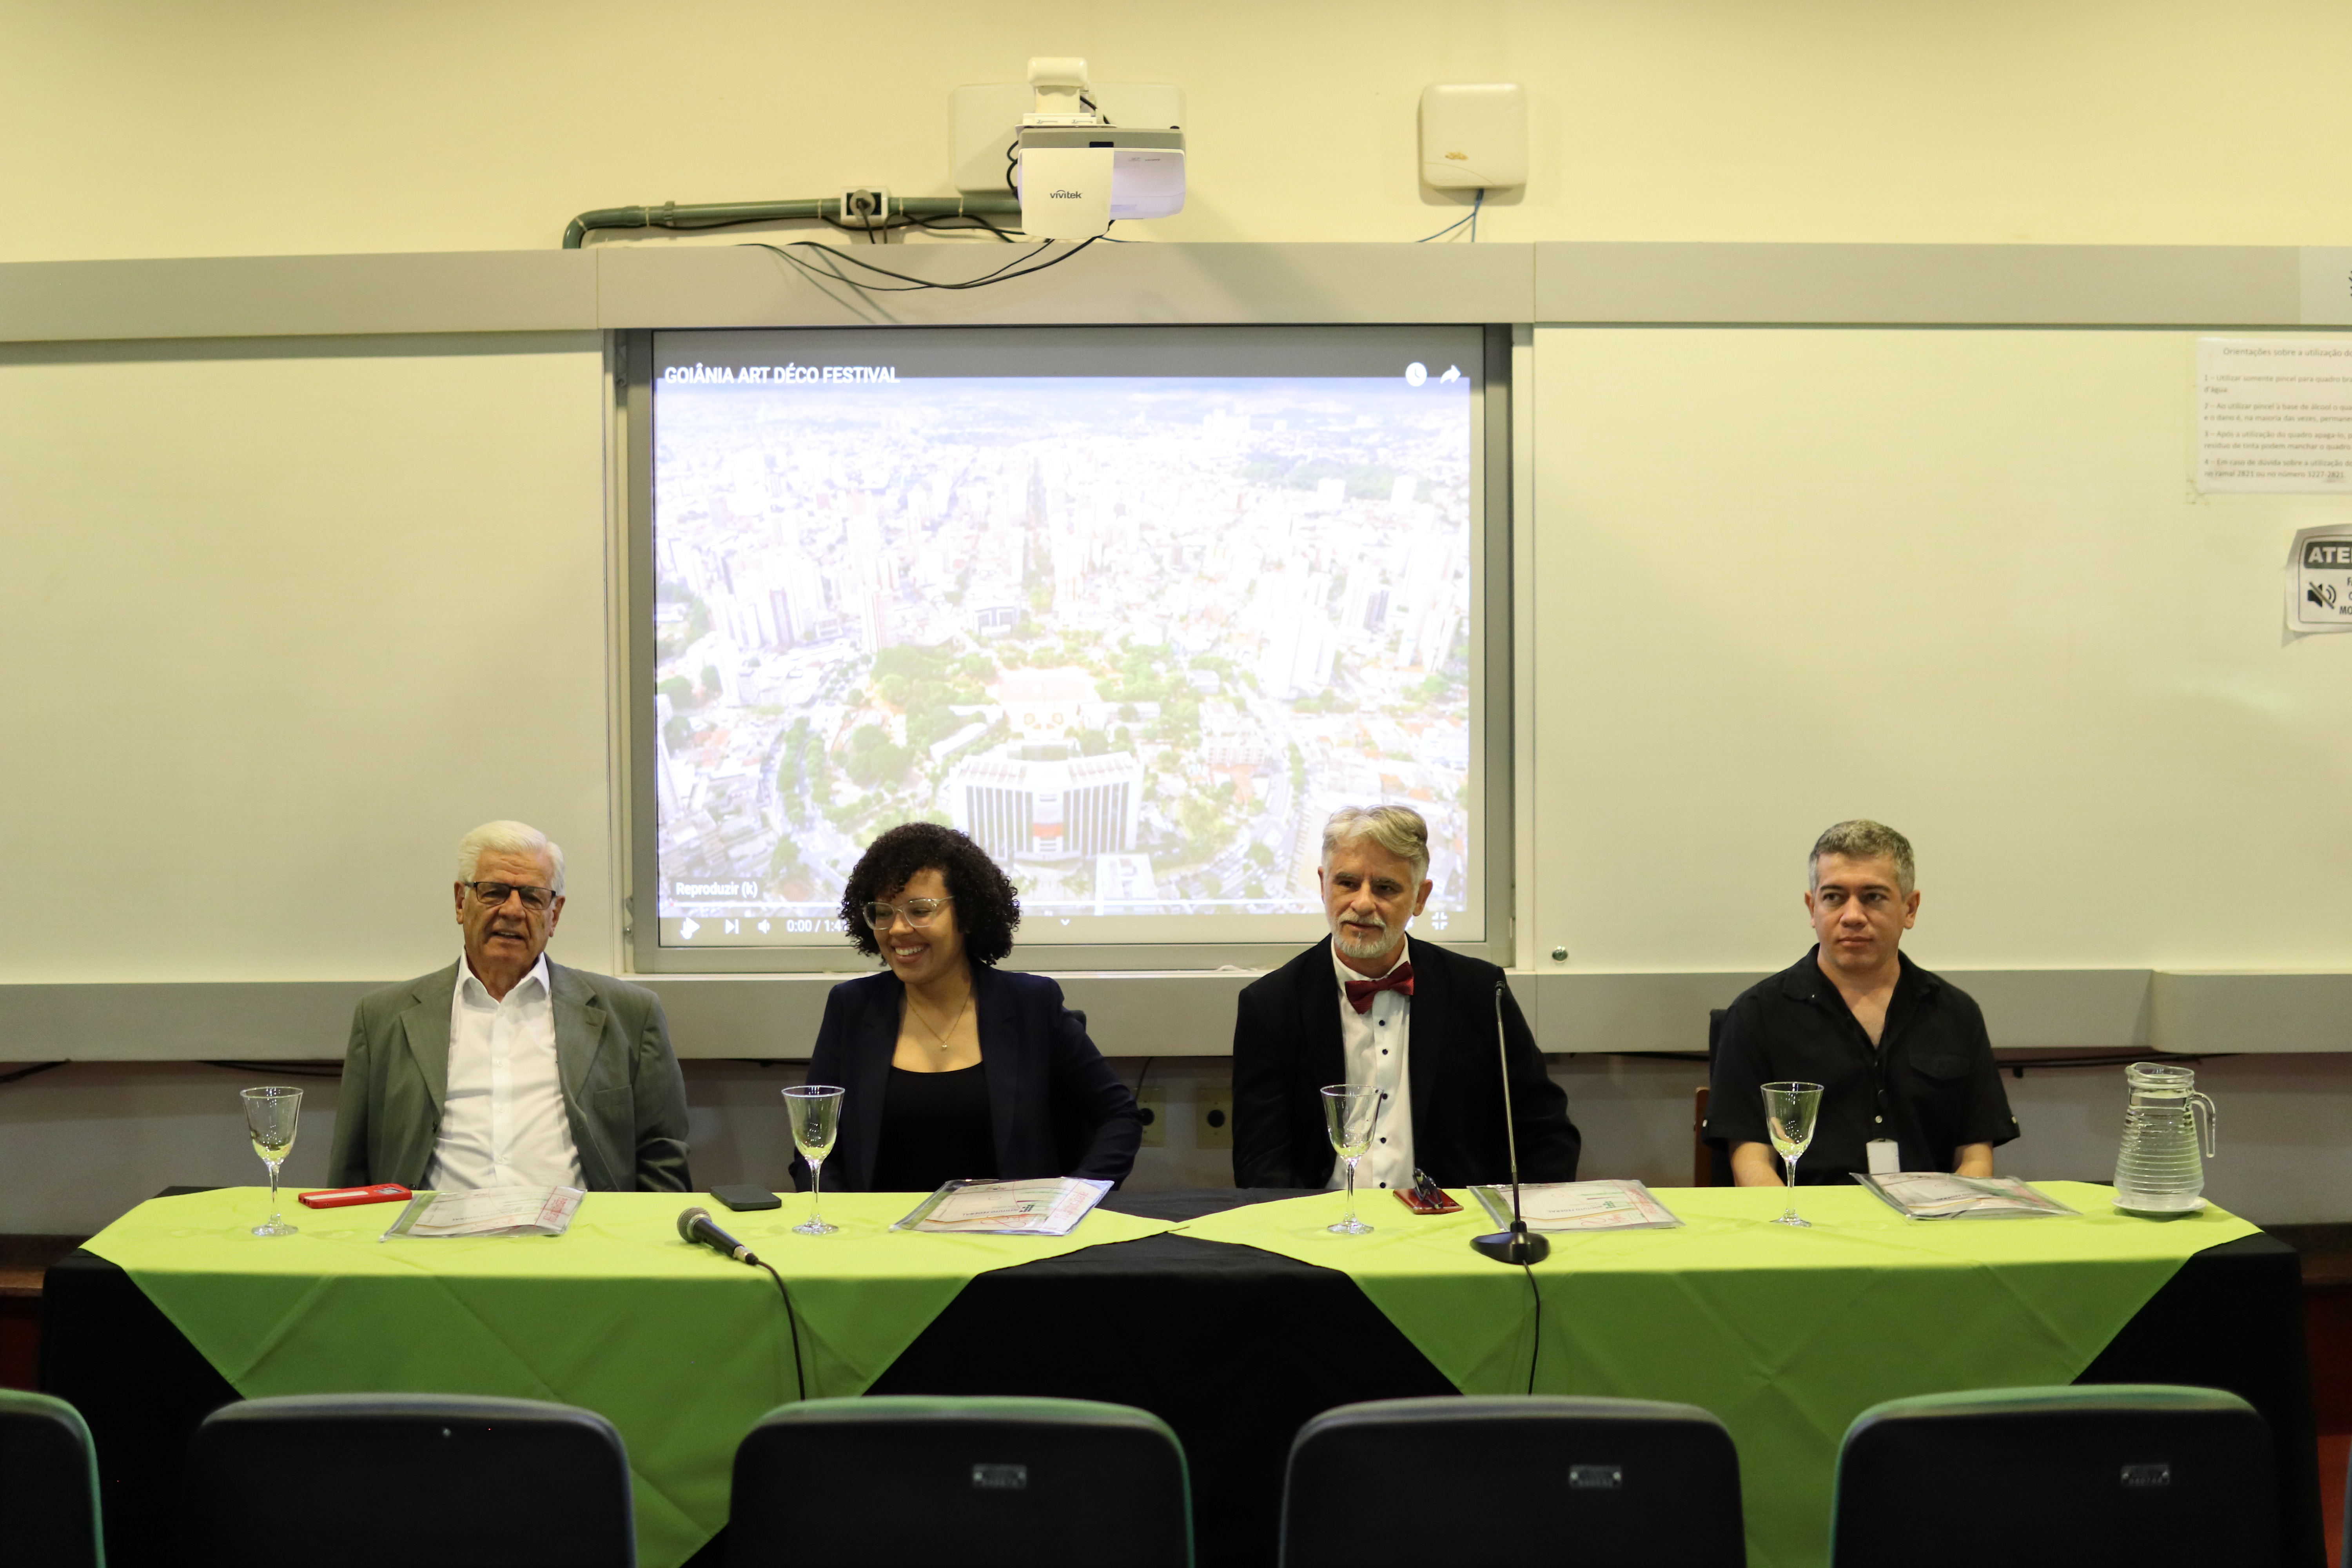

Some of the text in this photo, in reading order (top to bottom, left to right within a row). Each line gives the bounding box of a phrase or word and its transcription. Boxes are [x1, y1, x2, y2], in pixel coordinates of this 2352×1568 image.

[1050, 190, 1082, 198] vivitek
[2223, 347, 2271, 357] Orientações
[665, 362, 900, 384] GOIÂNIA ART DÉCO FESTIVAL
[2308, 546, 2352, 563] ATE
[676, 881, 758, 898] Reproduzir (k)
[787, 919, 812, 932] 0:00
[814, 919, 821, 933] /
